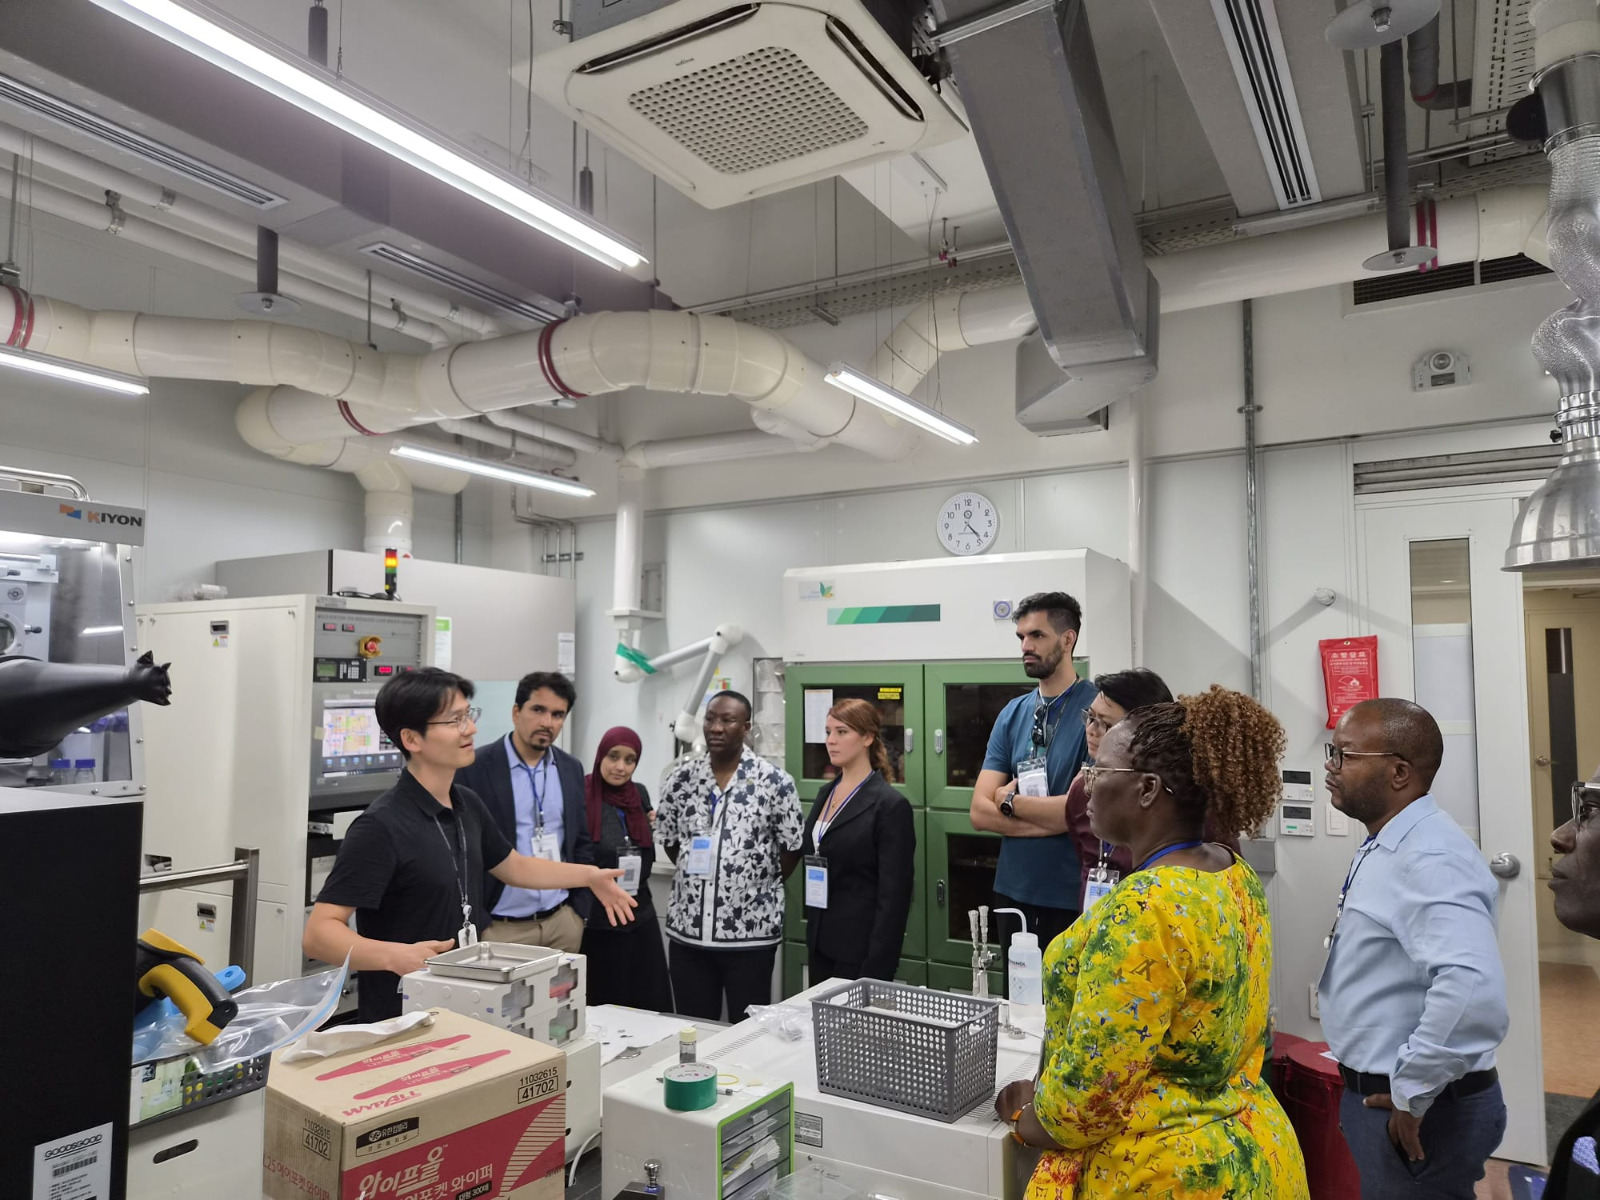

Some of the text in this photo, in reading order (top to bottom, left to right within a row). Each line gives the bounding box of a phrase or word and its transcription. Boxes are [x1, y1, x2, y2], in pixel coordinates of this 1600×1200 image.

[955, 503, 961, 511] 11
[964, 499, 972, 507] 12
[947, 511, 955, 519] 10
[984, 509, 990, 517] 2
[87, 511, 143, 527] KIYON
[944, 522, 950, 530] 9
[987, 520, 993, 528] 3
[947, 533, 953, 541] 8
[983, 531, 989, 539] 4
[955, 540, 961, 548] 7
[965, 542, 971, 550] 6
[520, 1066, 557, 1086] 11032615
[522, 1079, 555, 1099] 41702
[304, 1117, 331, 1140] 11032615
[45, 1133, 103, 1158] GOODSGOOD
[305, 1133, 329, 1157] 41702
[450, 1163, 493, 1192] 와이퍼
